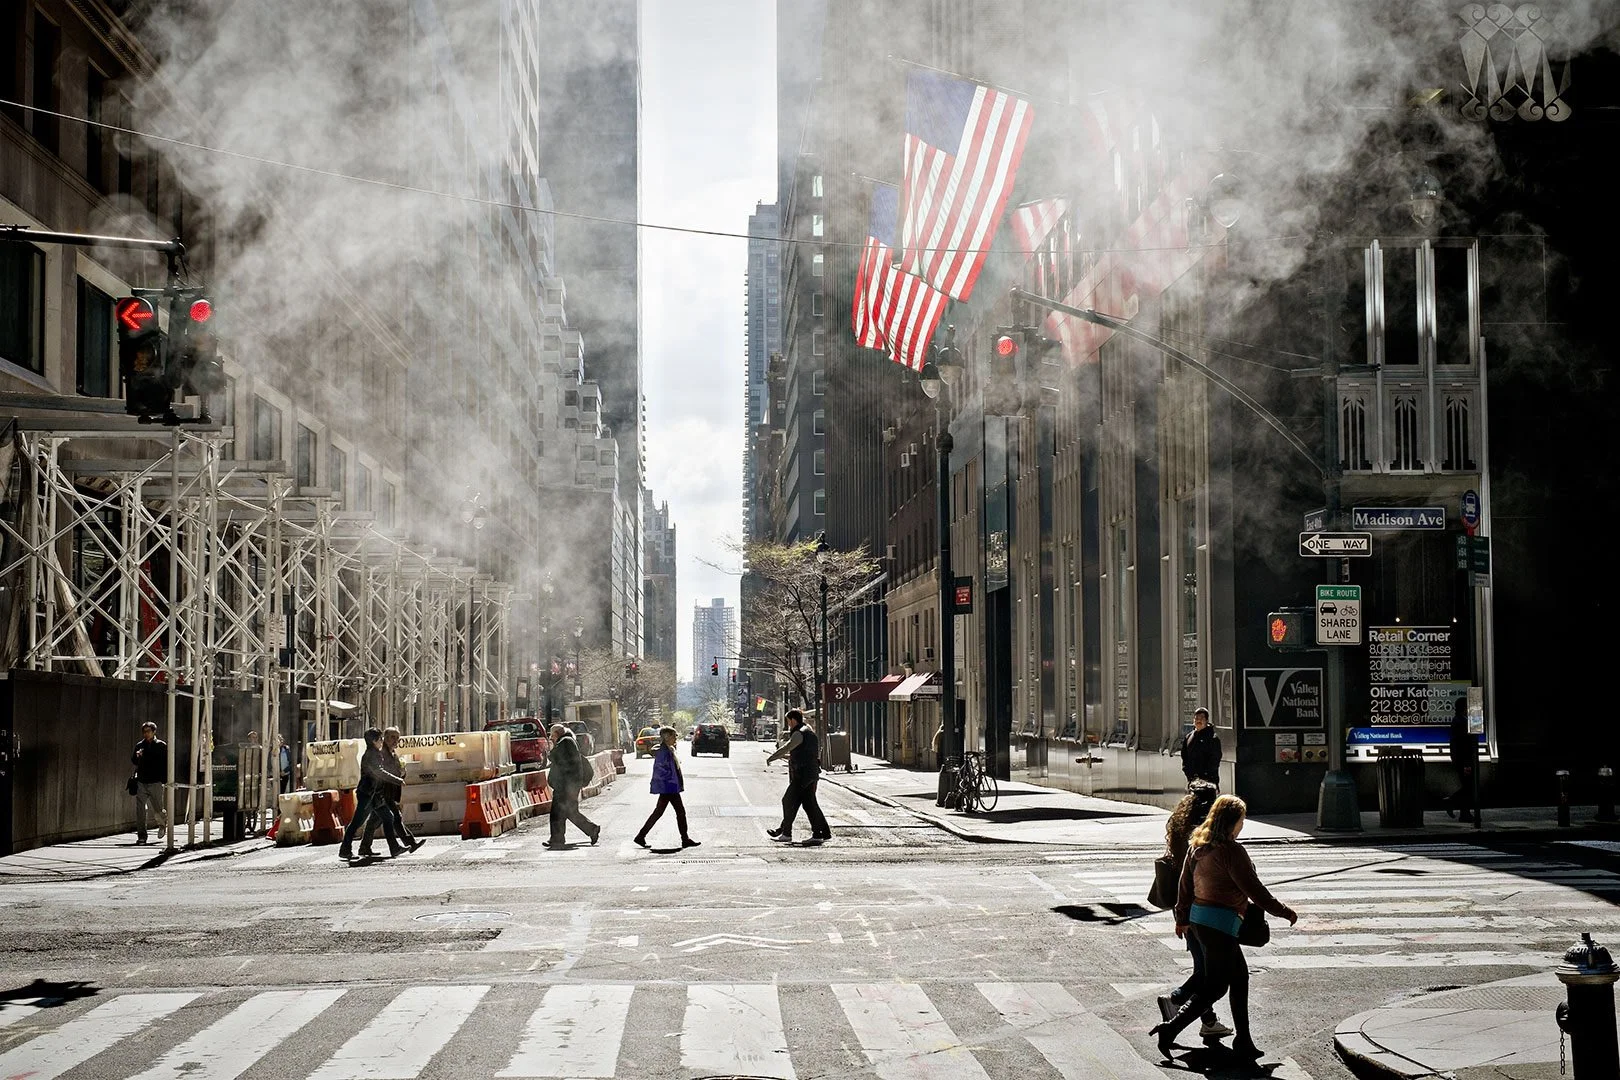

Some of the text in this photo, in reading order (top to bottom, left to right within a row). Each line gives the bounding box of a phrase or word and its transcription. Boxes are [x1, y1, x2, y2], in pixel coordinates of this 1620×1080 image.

[1355, 512, 1443, 526] Madison Ave
[1307, 540, 1365, 549] ONE WAY
[1320, 589, 1357, 597] BIKE ROUTE
[1320, 618, 1358, 627] SHARED
[1326, 630, 1351, 639] LANE
[1369, 630, 1451, 642] Retail Corner
[1421, 643, 1451, 654] Lease
[1421, 660, 1451, 672] Height
[1412, 672, 1452, 681] Storefront
[1290, 681, 1319, 695] Valley
[1370, 687, 1405, 698] Oliver
[1407, 687, 1451, 698] Katcher
[1282, 696, 1319, 706] National
[1370, 699, 1452, 713] 212 883 0526
[1296, 708, 1320, 718] Bank
[1354, 731, 1370, 740] Valley
[395, 734, 457, 749] OMMODORE
